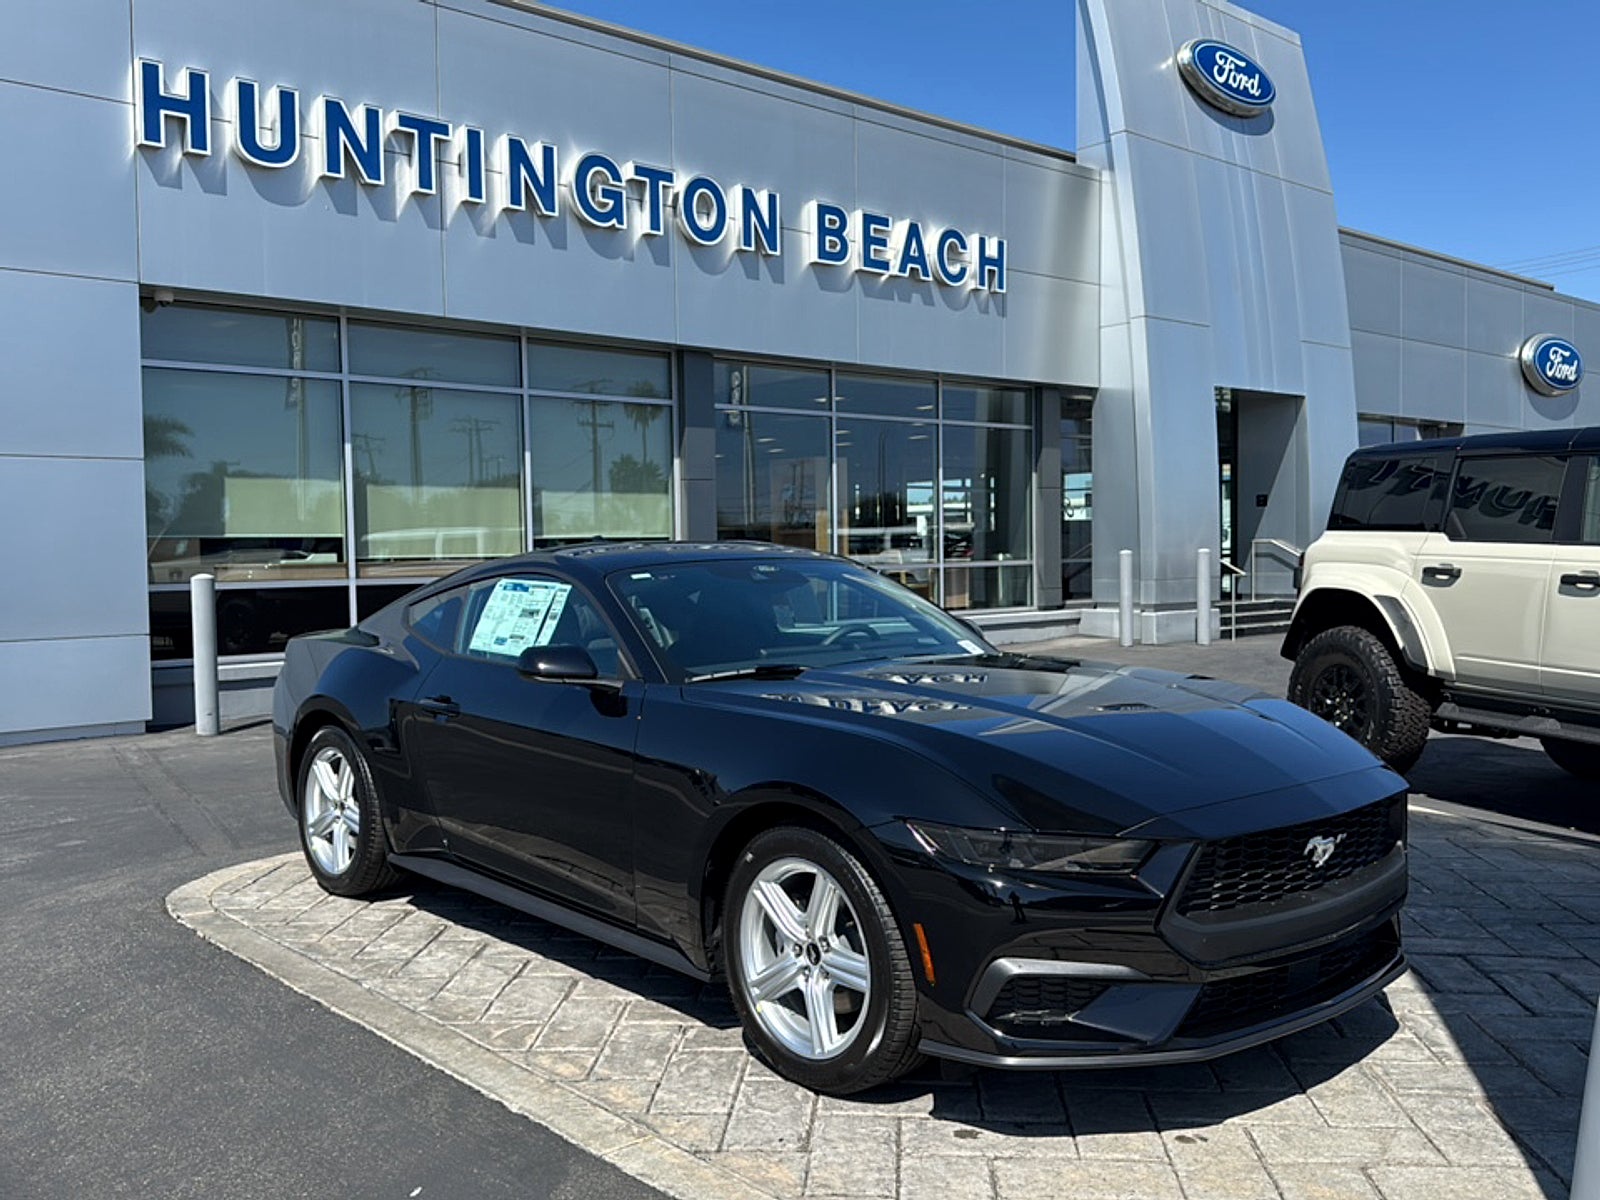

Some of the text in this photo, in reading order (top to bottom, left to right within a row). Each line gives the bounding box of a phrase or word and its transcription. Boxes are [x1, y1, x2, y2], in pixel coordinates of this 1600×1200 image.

[1213, 51, 1261, 96] Ford
[138, 58, 1007, 292] HUNTINGTON BEACH
[1546, 346, 1578, 382] Ford
